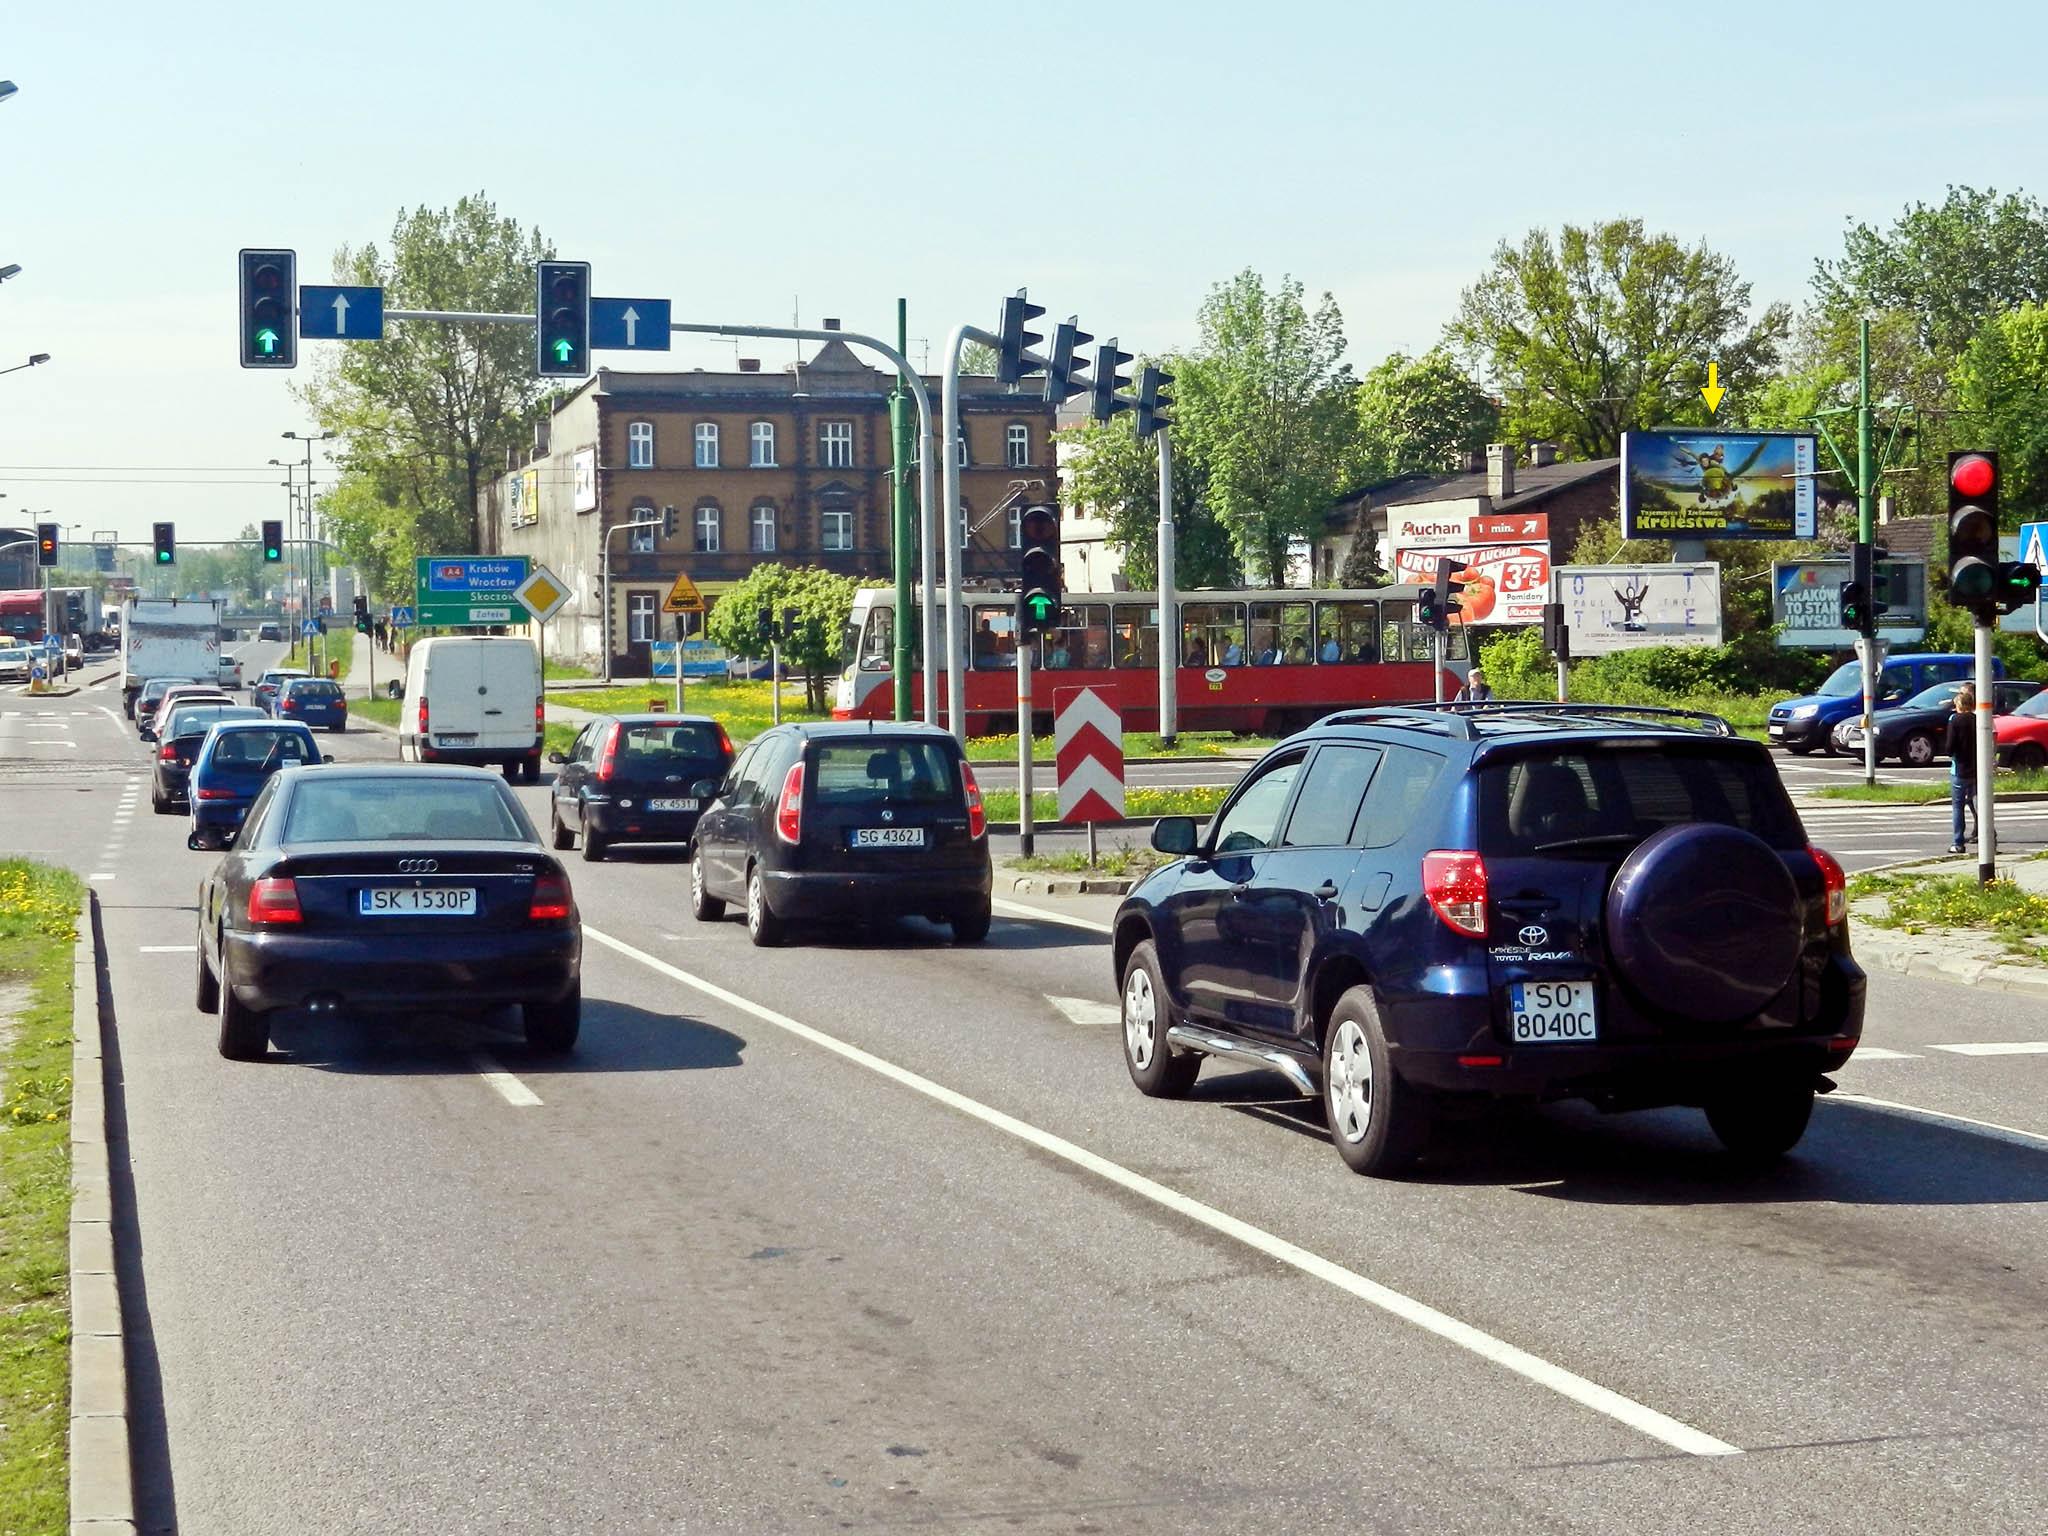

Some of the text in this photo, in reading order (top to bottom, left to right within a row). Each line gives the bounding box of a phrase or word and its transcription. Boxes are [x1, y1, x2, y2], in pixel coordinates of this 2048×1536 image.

[1401, 521, 1461, 536] Auchan
[1477, 522, 1515, 534] 1 min.
[1636, 514, 1727, 529] Królestwa
[1401, 546, 1521, 573] URONY AUCHAN!
[447, 568, 461, 576] A4
[468, 563, 510, 574] Kraków
[468, 577, 516, 587] Wrocław
[1506, 593, 1544, 601] Pomidory
[1785, 601, 1839, 615] TO STAN
[1784, 614, 1839, 628] UMYSŁU
[653, 800, 666, 809] SK
[859, 829, 921, 843] SG 4362J
[374, 890, 471, 909] SK 1530P
[1535, 983, 1572, 1009] SO
[1517, 1011, 1593, 1039] 8040C
